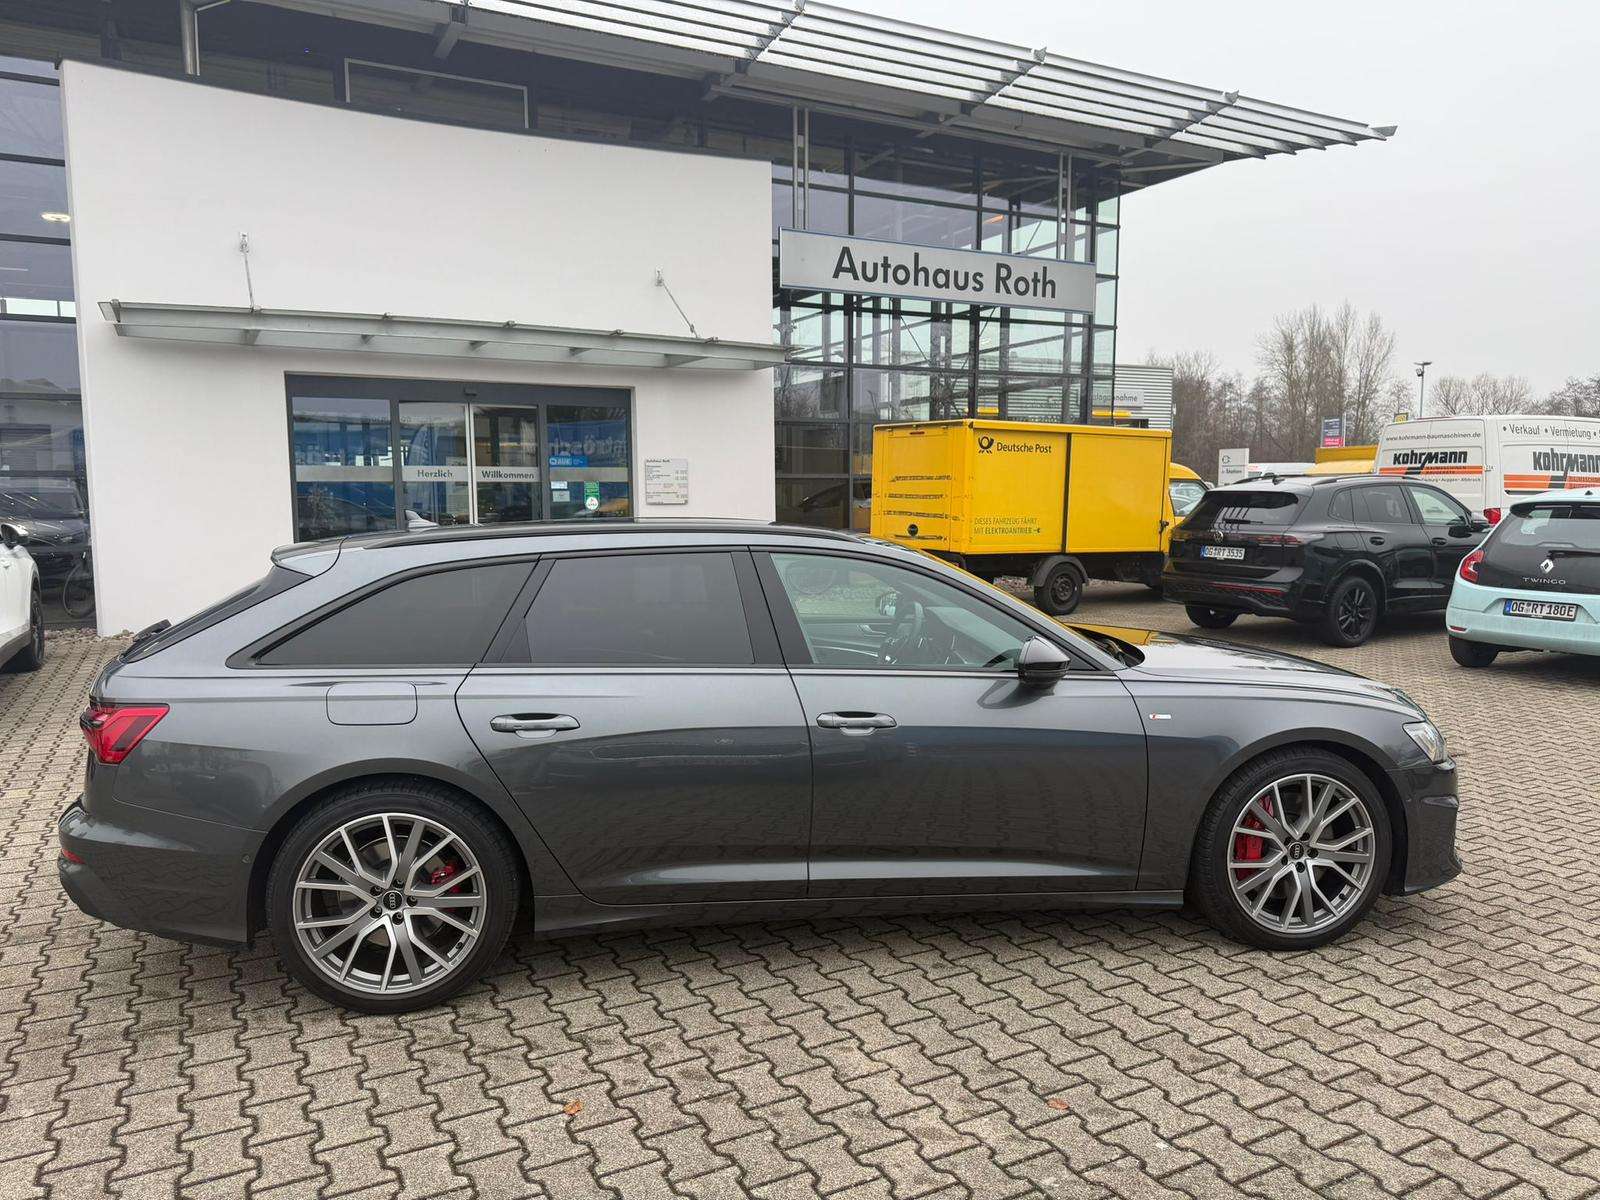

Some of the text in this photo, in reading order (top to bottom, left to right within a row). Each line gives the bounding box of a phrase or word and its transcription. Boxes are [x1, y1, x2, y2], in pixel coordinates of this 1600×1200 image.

[832, 246, 1057, 299] Autohaus Roth
[1509, 424, 1540, 435] Verkauf
[1550, 426, 1592, 440] Vermietung
[997, 442, 1052, 454] Deutsche Post
[417, 469, 535, 480] Herzlich Willkommen
[974, 517, 992, 525] DIESES
[992, 517, 1020, 525] FAHRZEUG
[974, 527, 1033, 535] MIT ELEKTROANTRIEB
[1523, 577, 1566, 585] TWINGO
[1511, 601, 1575, 617] OG RT 180E
